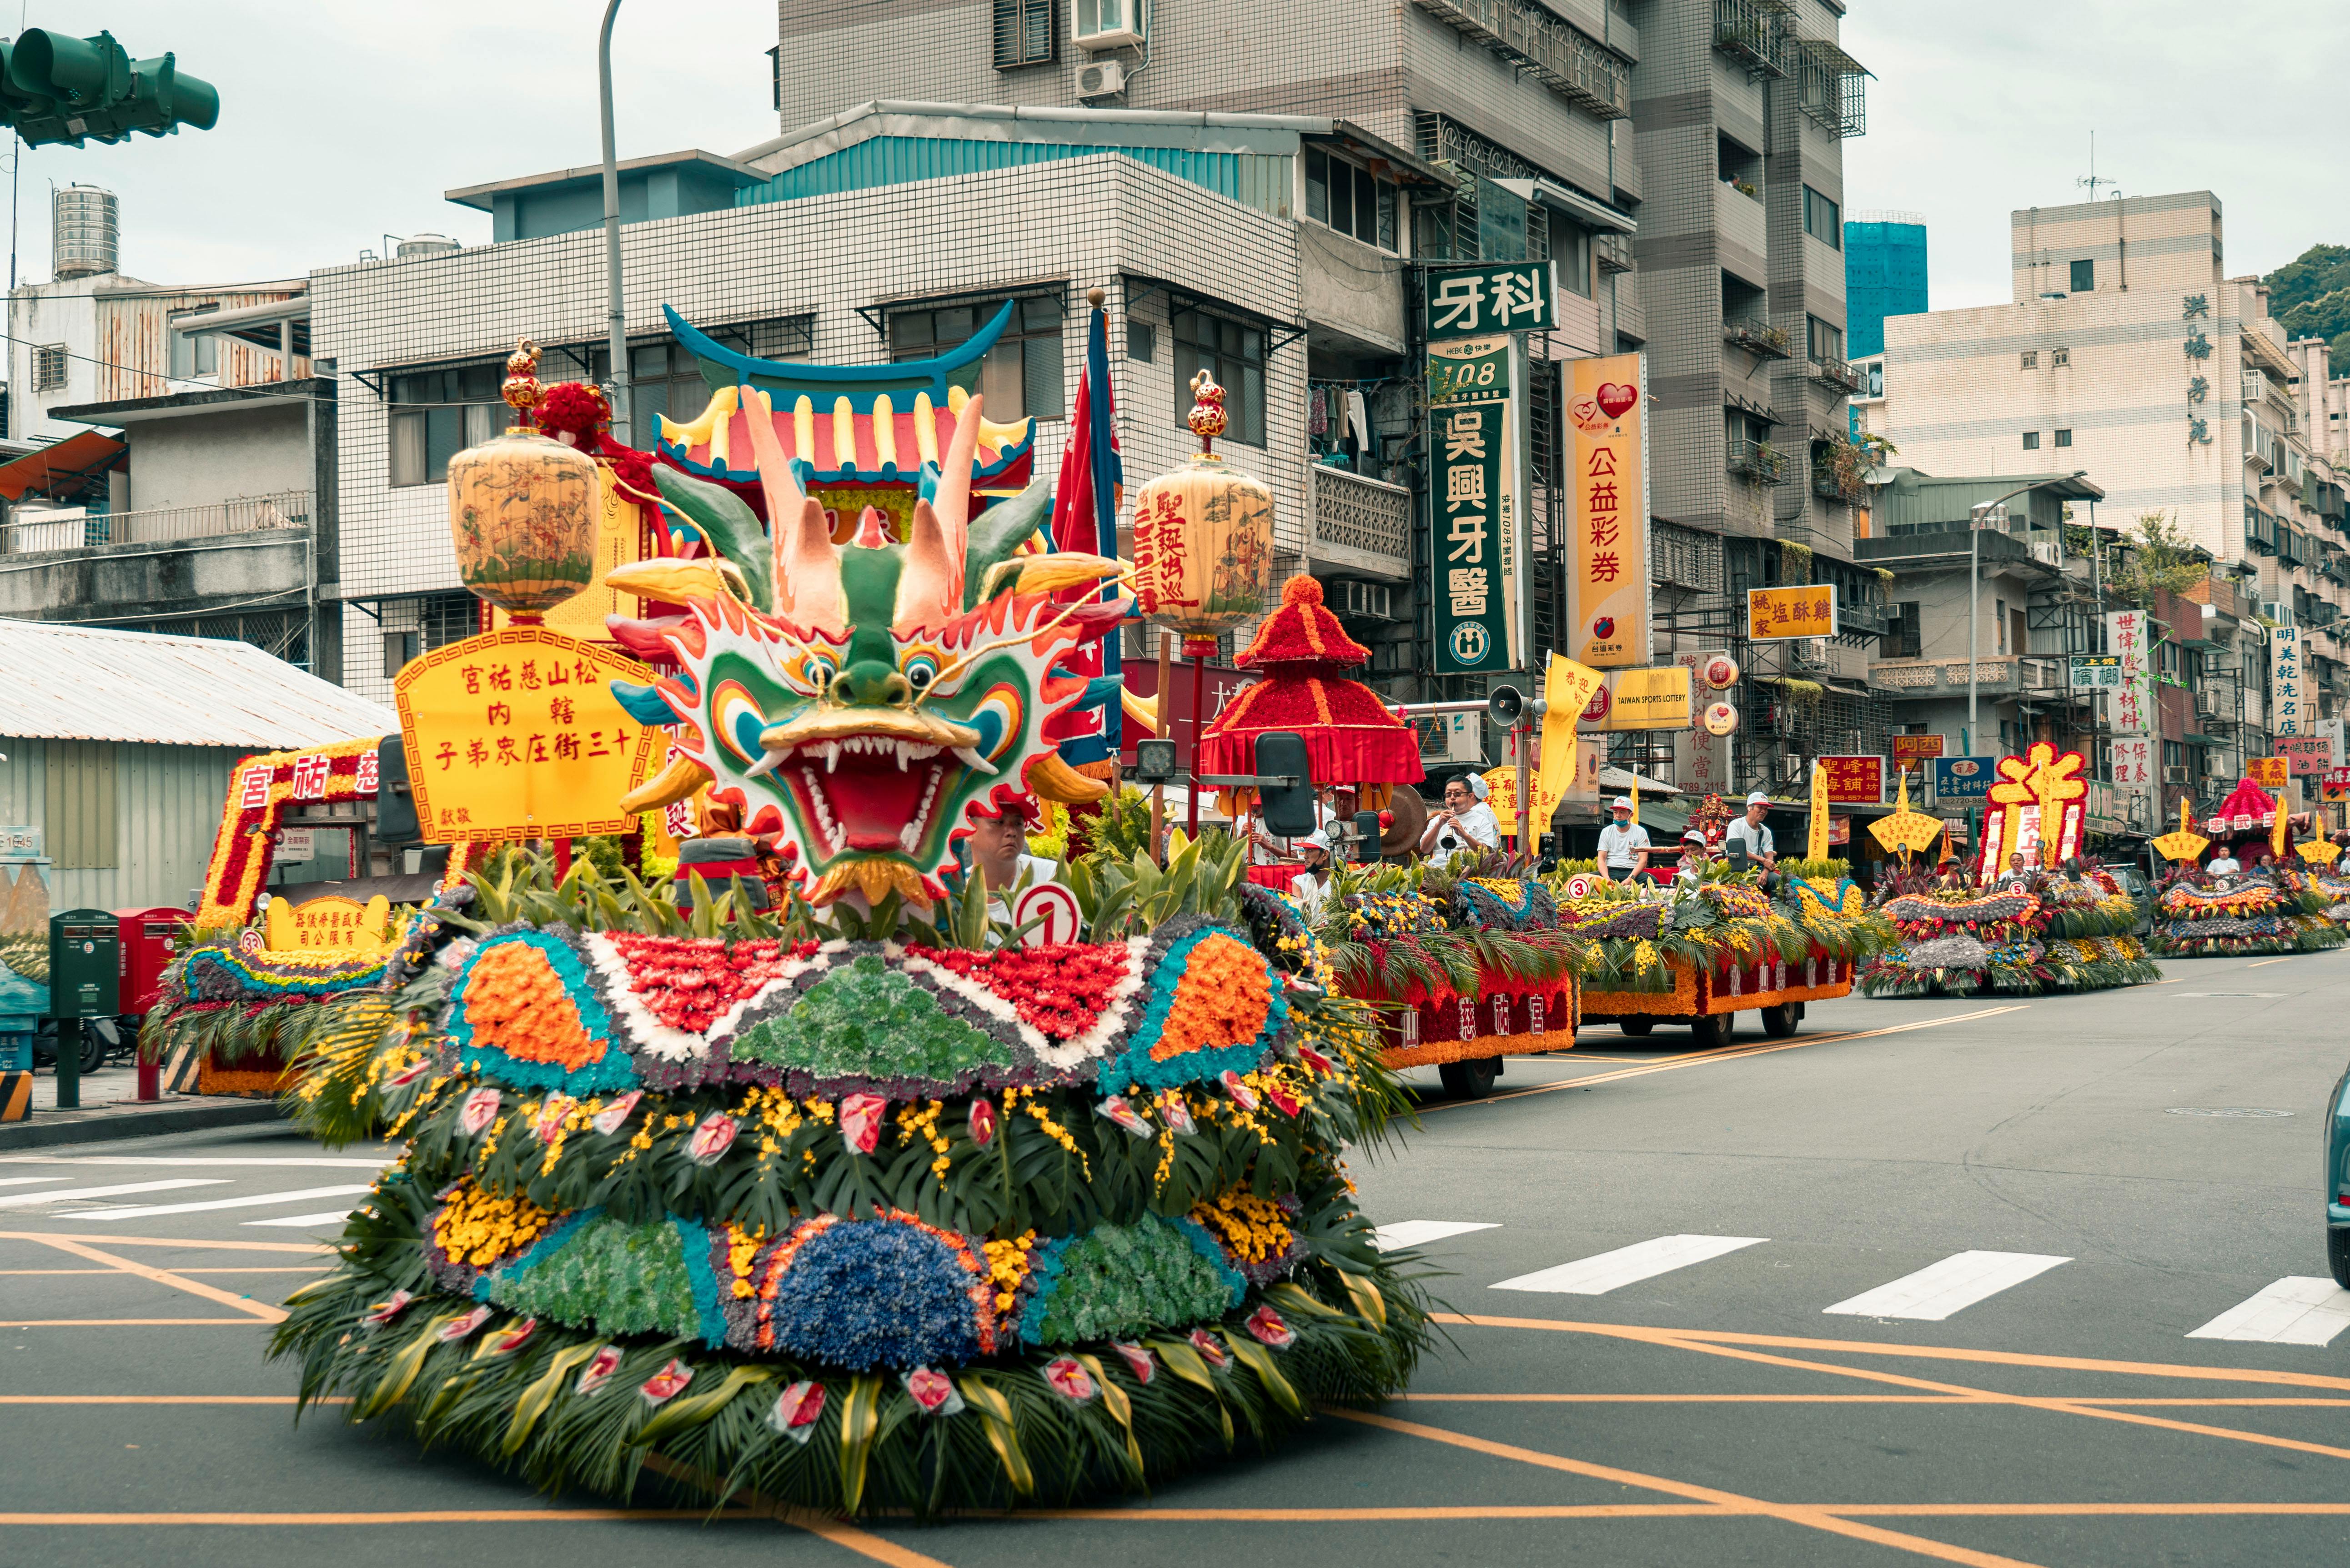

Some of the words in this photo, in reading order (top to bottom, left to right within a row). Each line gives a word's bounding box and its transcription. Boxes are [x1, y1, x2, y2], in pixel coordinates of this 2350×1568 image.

[1432, 268, 1544, 329] 牙科
[1475, 344, 1491, 352] 快樂
[1443, 362, 1496, 388] 108
[1451, 390, 1499, 401] 庭牙醫聯盟
[1445, 412, 1488, 616] 吳興牙醫
[1588, 447, 1619, 583] 公益彩券
[1154, 491, 1199, 608] 聖誕出巡
[461, 658, 601, 694] 松山慈祐宮
[2073, 668, 2119, 685] 檳榔
[2275, 628, 2298, 735] 明美乾洗名店
[1617, 696, 1641, 705] TAIWAN
[1642, 695, 1662, 704] SPORTS
[1662, 694, 1686, 703] LOTTERY
[2278, 741, 2329, 754] 大腸麵線
[1822, 759, 1863, 774] 聖峰
[1954, 763, 1977, 774] 百泰
[2115, 743, 2129, 782] 修理
[2133, 743, 2147, 783] 保養
[242, 750, 379, 809] 慈祐宮
[1678, 781, 1725, 792] 8789-2115
[440, 807, 472, 826] 敬獻
[1574, 884, 1583, 896] 3
[2014, 885, 2021, 894] 5
[1037, 901, 1054, 946] 1
[246, 937, 258, 951] 33
[300, 930, 355, 946] 有限公司
